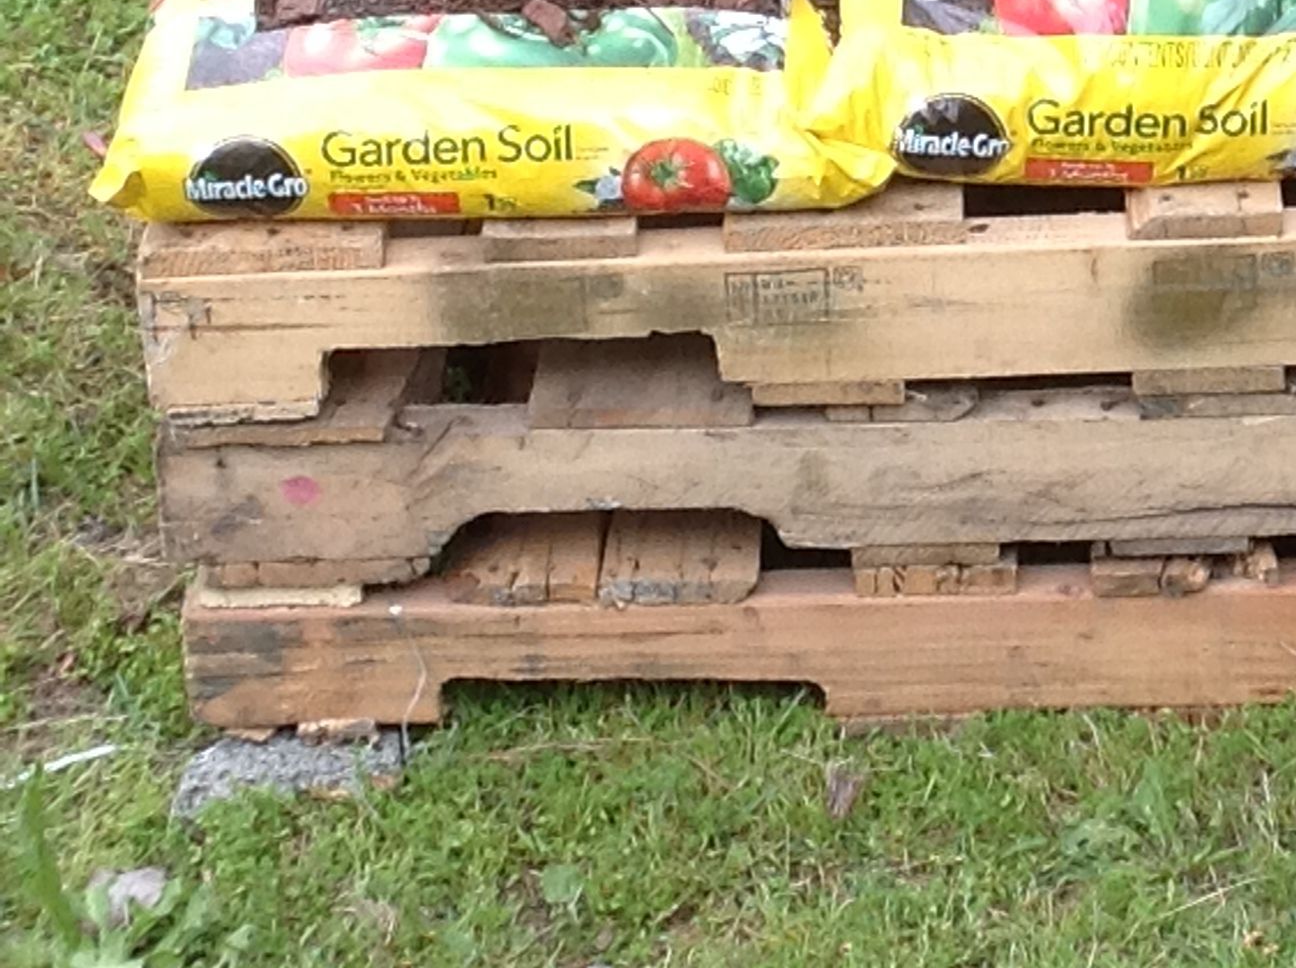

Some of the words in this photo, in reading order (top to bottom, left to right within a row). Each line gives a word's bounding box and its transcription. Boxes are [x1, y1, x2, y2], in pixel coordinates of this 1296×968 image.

[1027, 98, 1187, 139] Garden
[1195, 98, 1268, 137] Soil
[321, 129, 487, 168] Garden
[497, 123, 573, 163] Soil
[184, 172, 309, 201] Miracle-Gro
